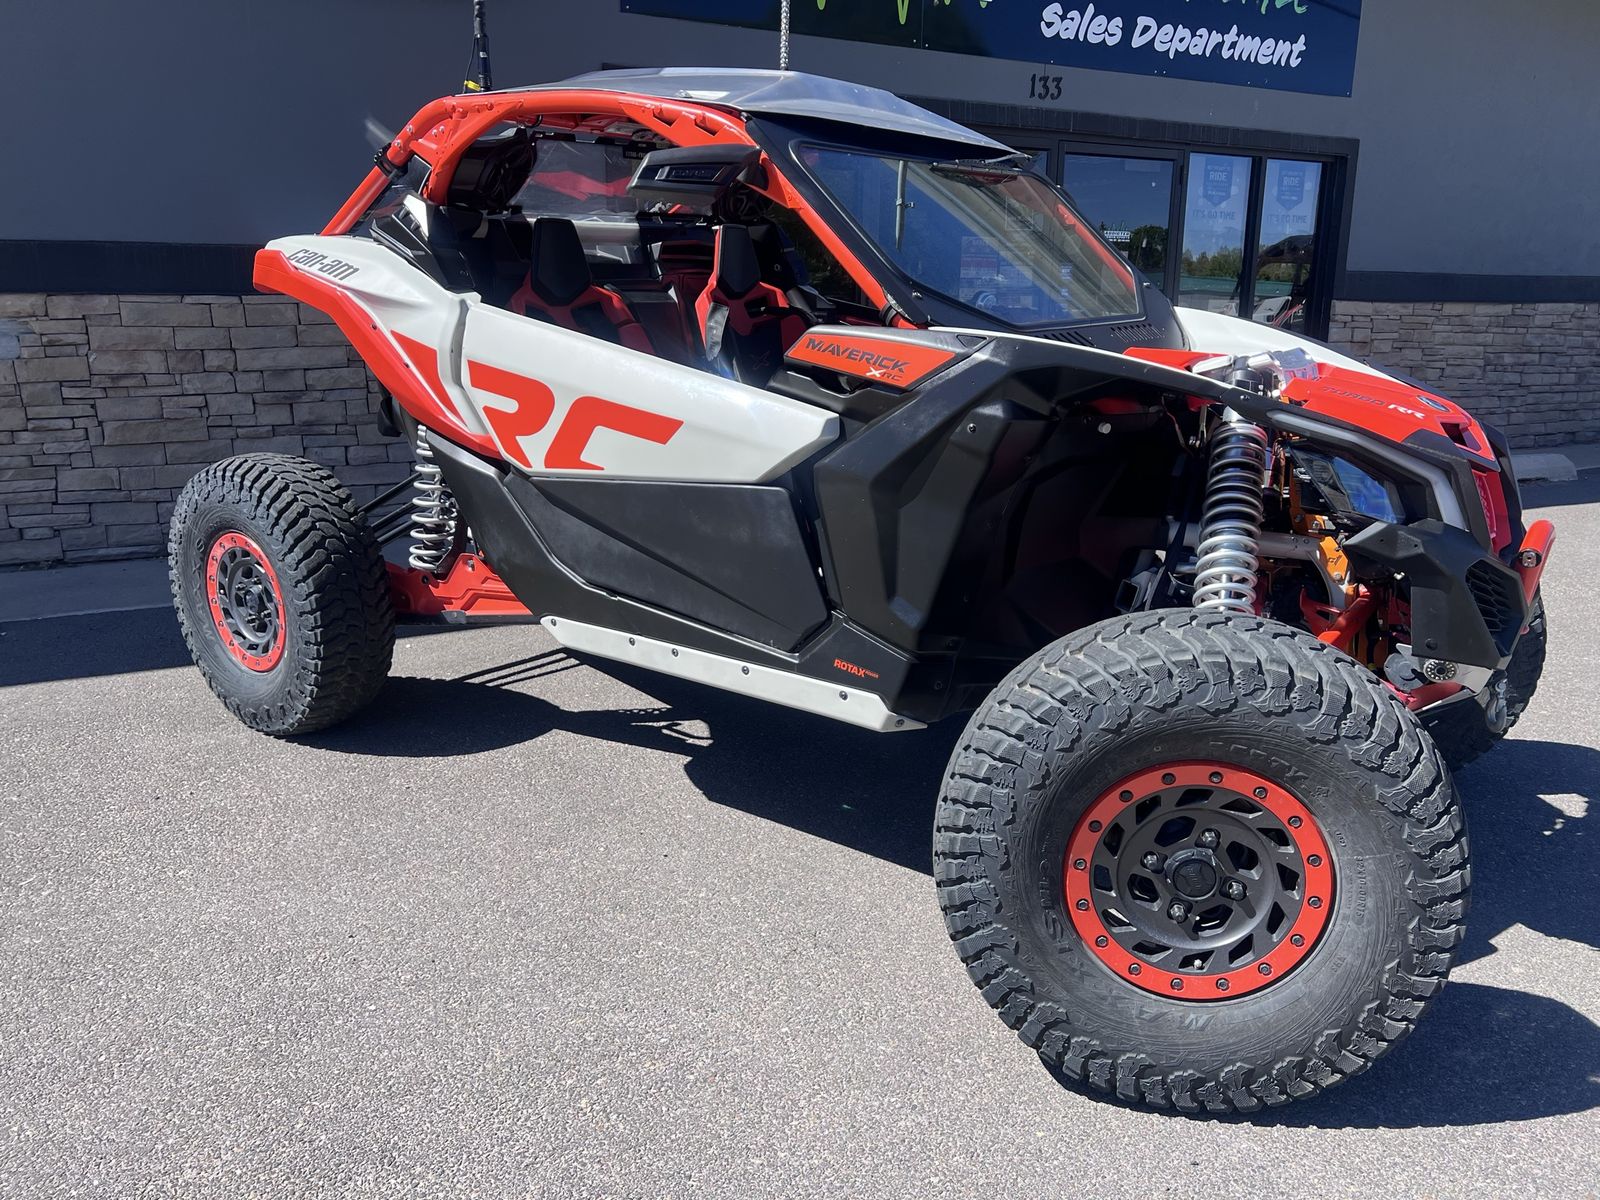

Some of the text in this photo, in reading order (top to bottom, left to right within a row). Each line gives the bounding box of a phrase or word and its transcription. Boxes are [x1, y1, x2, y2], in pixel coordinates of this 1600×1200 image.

[1040, 2, 1124, 47] Sales
[1131, 15, 1306, 68] Department
[1029, 74, 1063, 100] 133
[1210, 172, 1228, 182] RIDE
[805, 337, 912, 374] MAVERICK
[1324, 387, 1425, 419] TURBO RR
[833, 658, 866, 678] ROTAX
